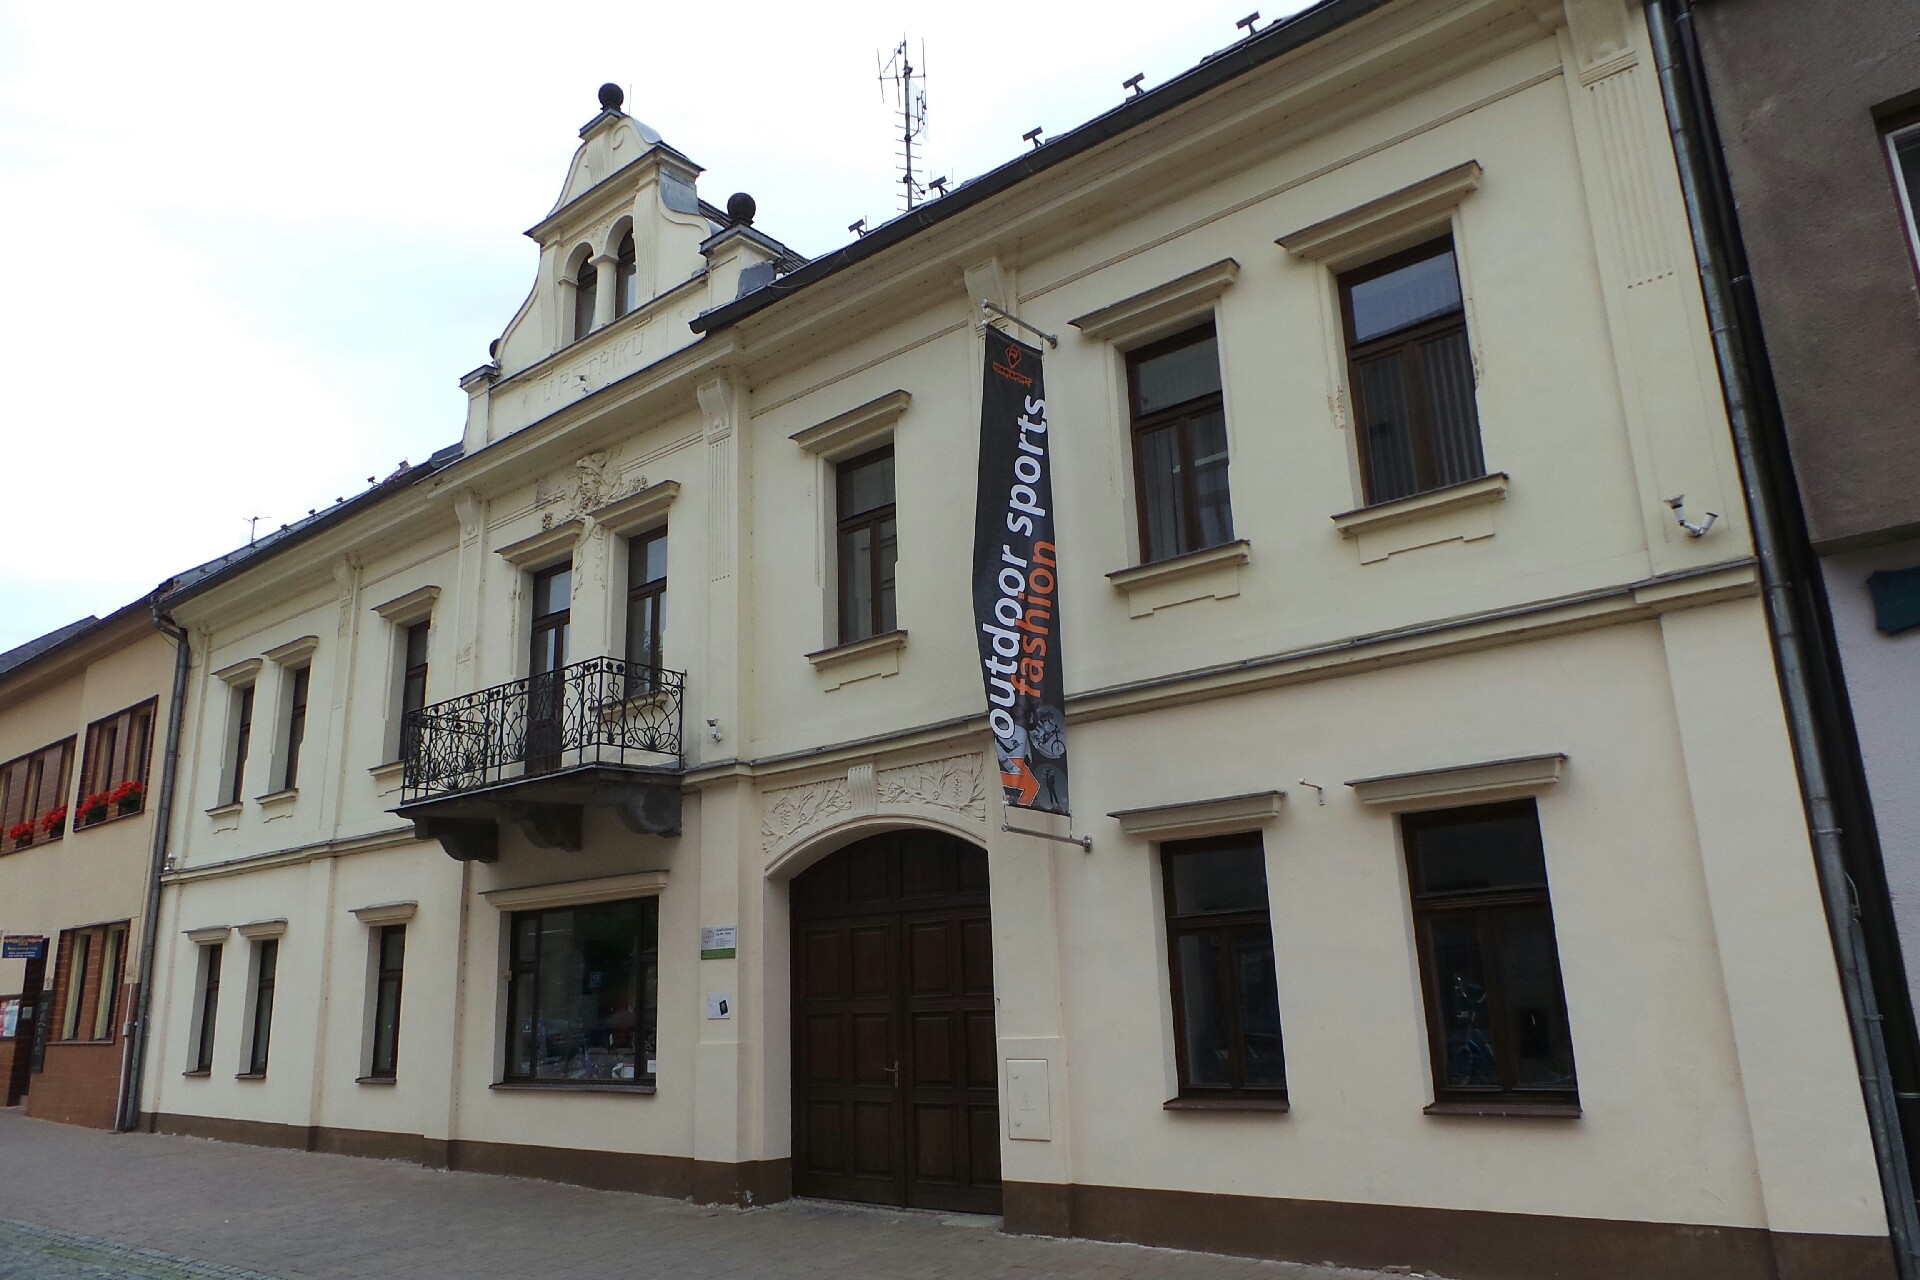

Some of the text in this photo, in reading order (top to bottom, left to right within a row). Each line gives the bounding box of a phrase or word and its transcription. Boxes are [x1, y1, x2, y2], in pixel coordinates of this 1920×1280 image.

[982, 544, 1028, 740] outdoor
[1006, 394, 1048, 537] sports
[1010, 540, 1056, 698] fashion
